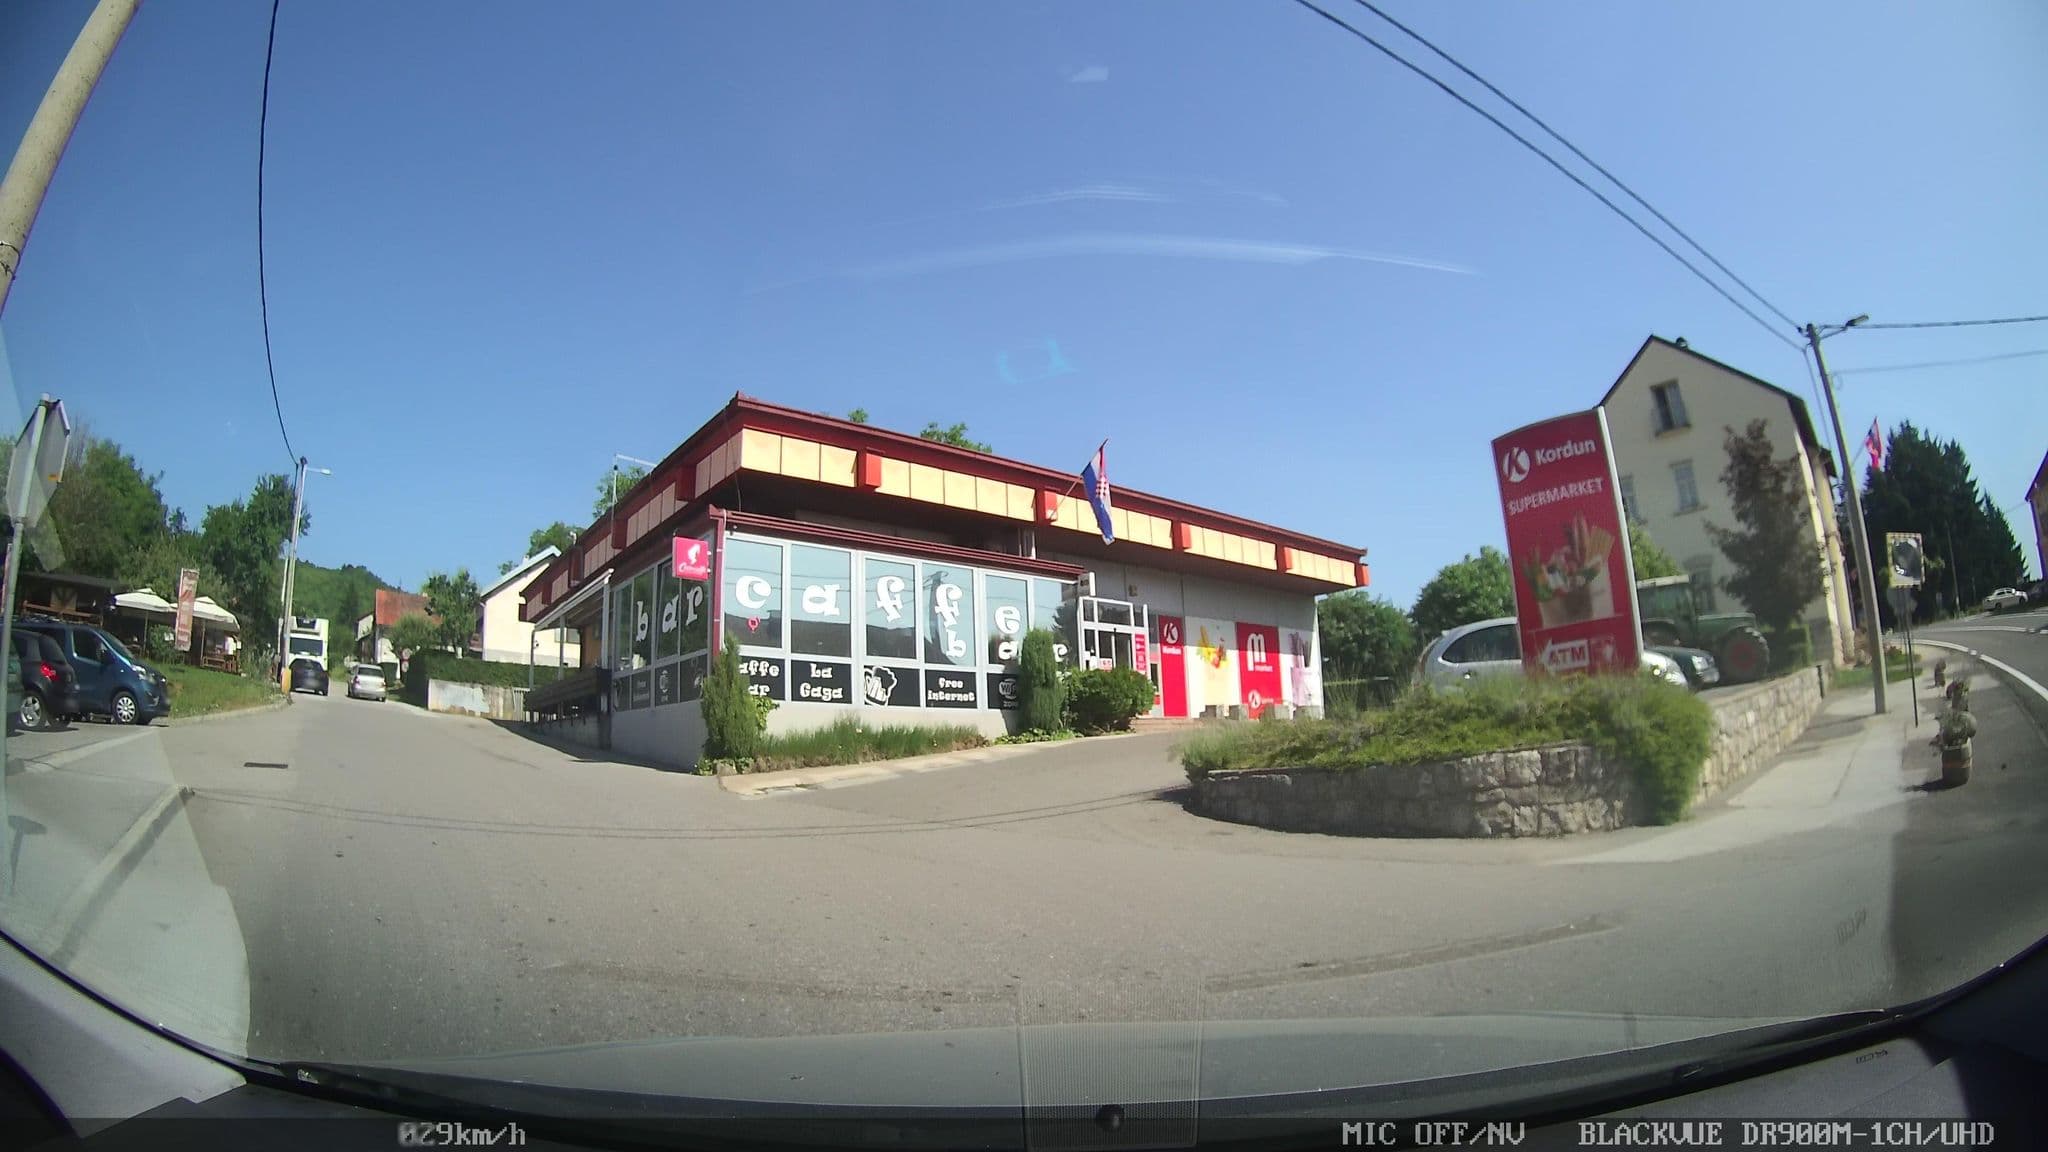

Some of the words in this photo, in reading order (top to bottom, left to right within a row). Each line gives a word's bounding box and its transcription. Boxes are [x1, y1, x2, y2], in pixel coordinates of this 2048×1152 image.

[1535, 439, 1597, 466] Kordun
[1505, 476, 1603, 516] SUPERMARKET
[635, 585, 704, 642] bar
[1549, 647, 1586, 666] ATM
[739, 659, 780, 677] affe
[810, 663, 833, 679] La
[747, 683, 771, 697] ar
[800, 682, 843, 701] Gaga
[938, 677, 964, 689] free
[927, 690, 976, 702] internet
